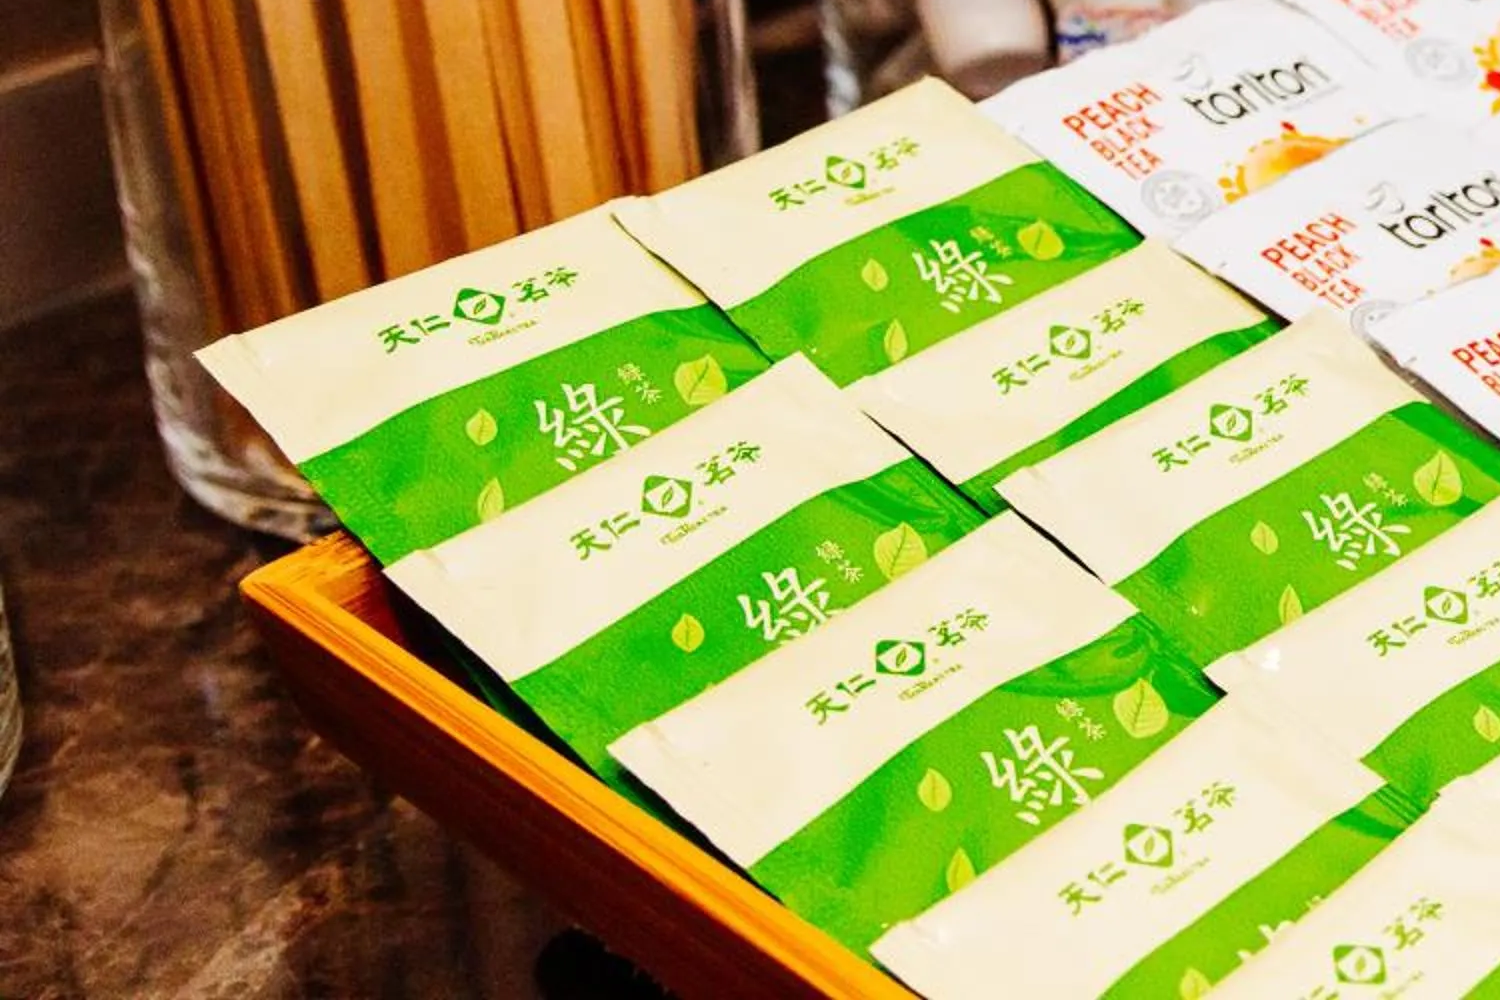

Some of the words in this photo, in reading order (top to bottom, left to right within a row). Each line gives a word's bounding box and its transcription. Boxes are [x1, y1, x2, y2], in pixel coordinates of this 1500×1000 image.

[1062, 82, 1162, 140] PEACH
[1182, 60, 1331, 125] tarlton
[1090, 116, 1162, 161] BLACK
[1114, 147, 1164, 180] TEA
[768, 179, 827, 210] 天仁
[1261, 213, 1357, 271] PEACH
[912, 240, 1013, 313] 綠
[1291, 245, 1359, 292] BLACK
[1319, 278, 1366, 310] TEA
[378, 315, 451, 353] 天仁
[992, 354, 1050, 394] 天仁
[534, 383, 650, 471] 綠
[1151, 435, 1211, 472] 天仁
[570, 511, 641, 560] 天仁
[1301, 492, 1412, 571] 綠
[1366, 615, 1427, 656] 天仁
[805, 674, 877, 725] 天仁
[980, 725, 1104, 825] 綠
[1058, 862, 1127, 916] 天仁
